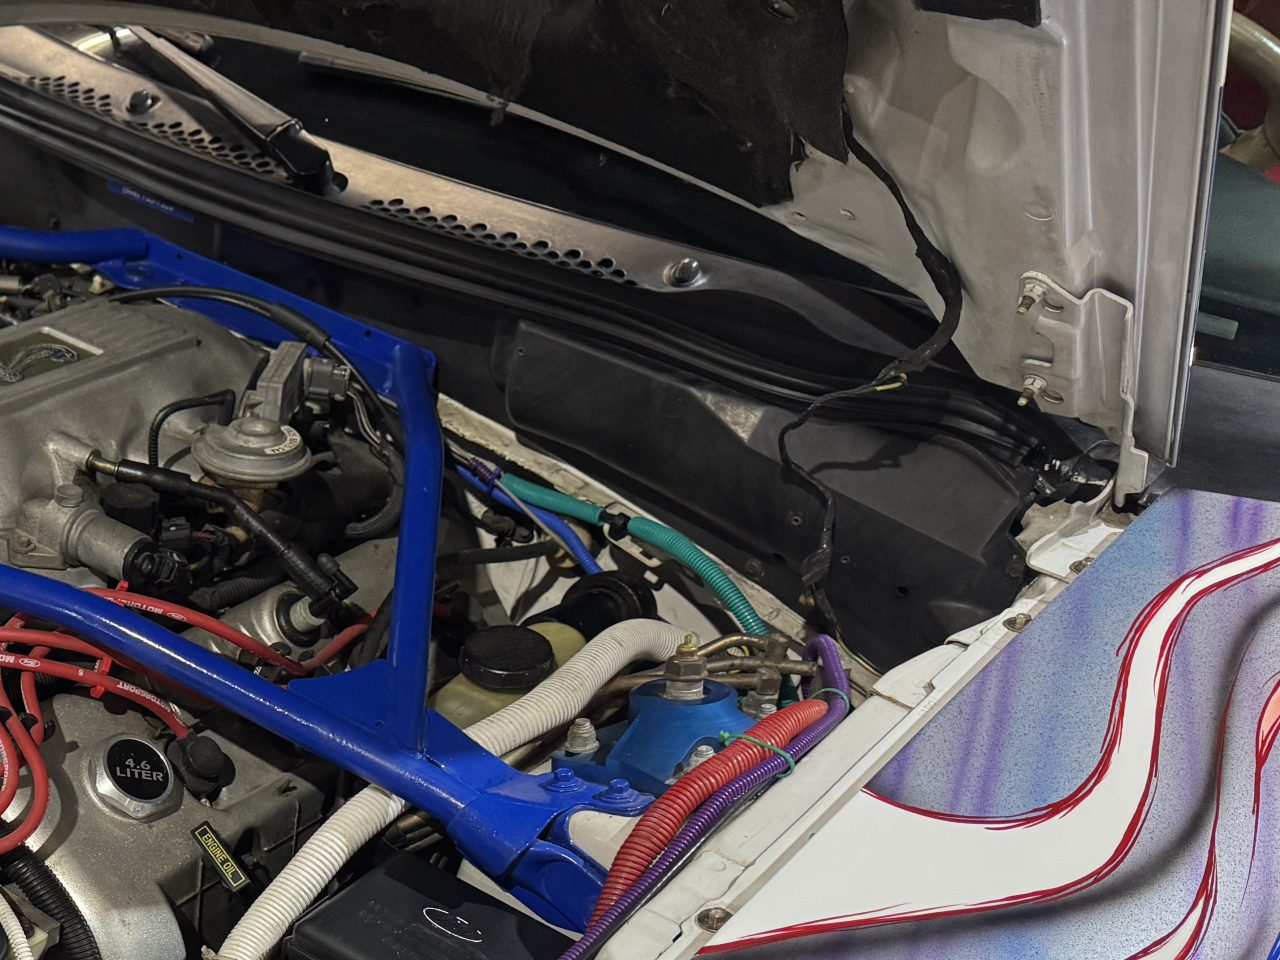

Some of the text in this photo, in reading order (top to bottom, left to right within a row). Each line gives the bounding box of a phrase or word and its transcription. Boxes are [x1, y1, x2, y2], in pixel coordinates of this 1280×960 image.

[125, 758, 151, 770] 4.6
[116, 766, 164, 782] LITER
[201, 833, 235, 878] ENGINE OIL
